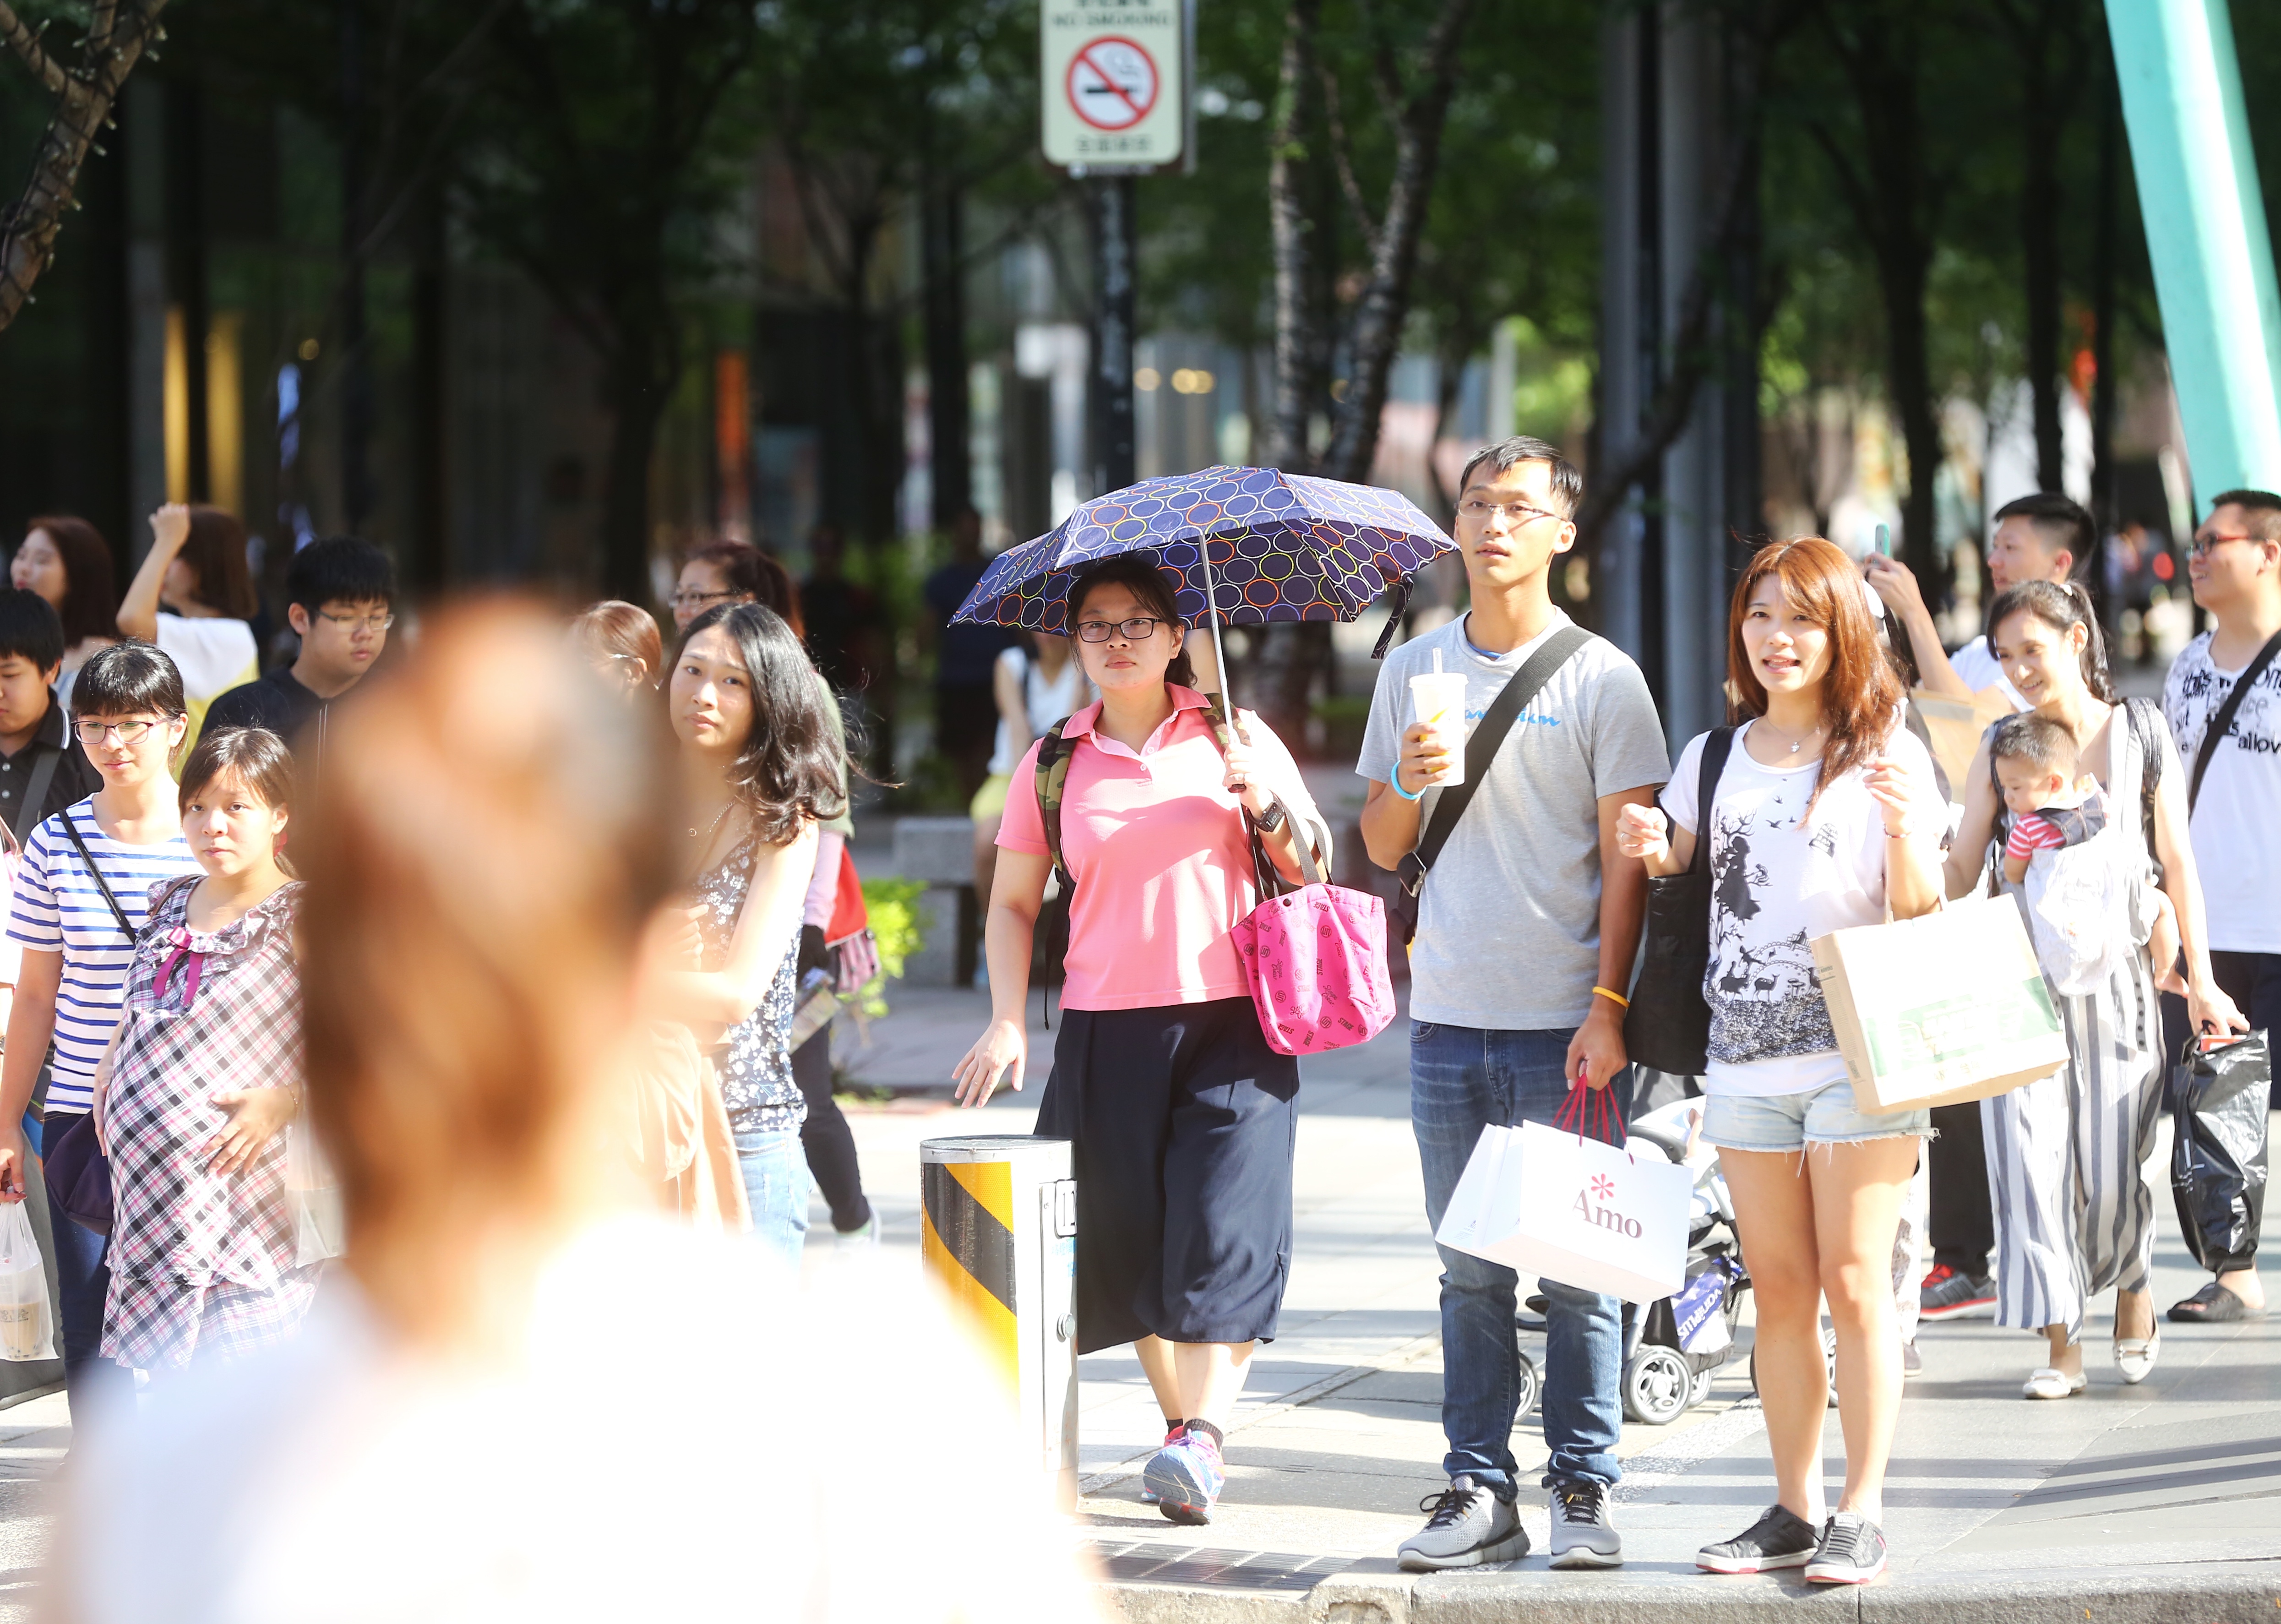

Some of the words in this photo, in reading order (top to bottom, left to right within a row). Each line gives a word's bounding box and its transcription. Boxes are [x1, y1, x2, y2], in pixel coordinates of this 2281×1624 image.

[1313, 901, 1330, 912] STAGE
[1278, 1023, 1294, 1034] STAGE
[1338, 1017, 1354, 1031] STAGE
[1303, 1030, 1314, 1047] STAGE
[1572, 1189, 1643, 1239] Amo
